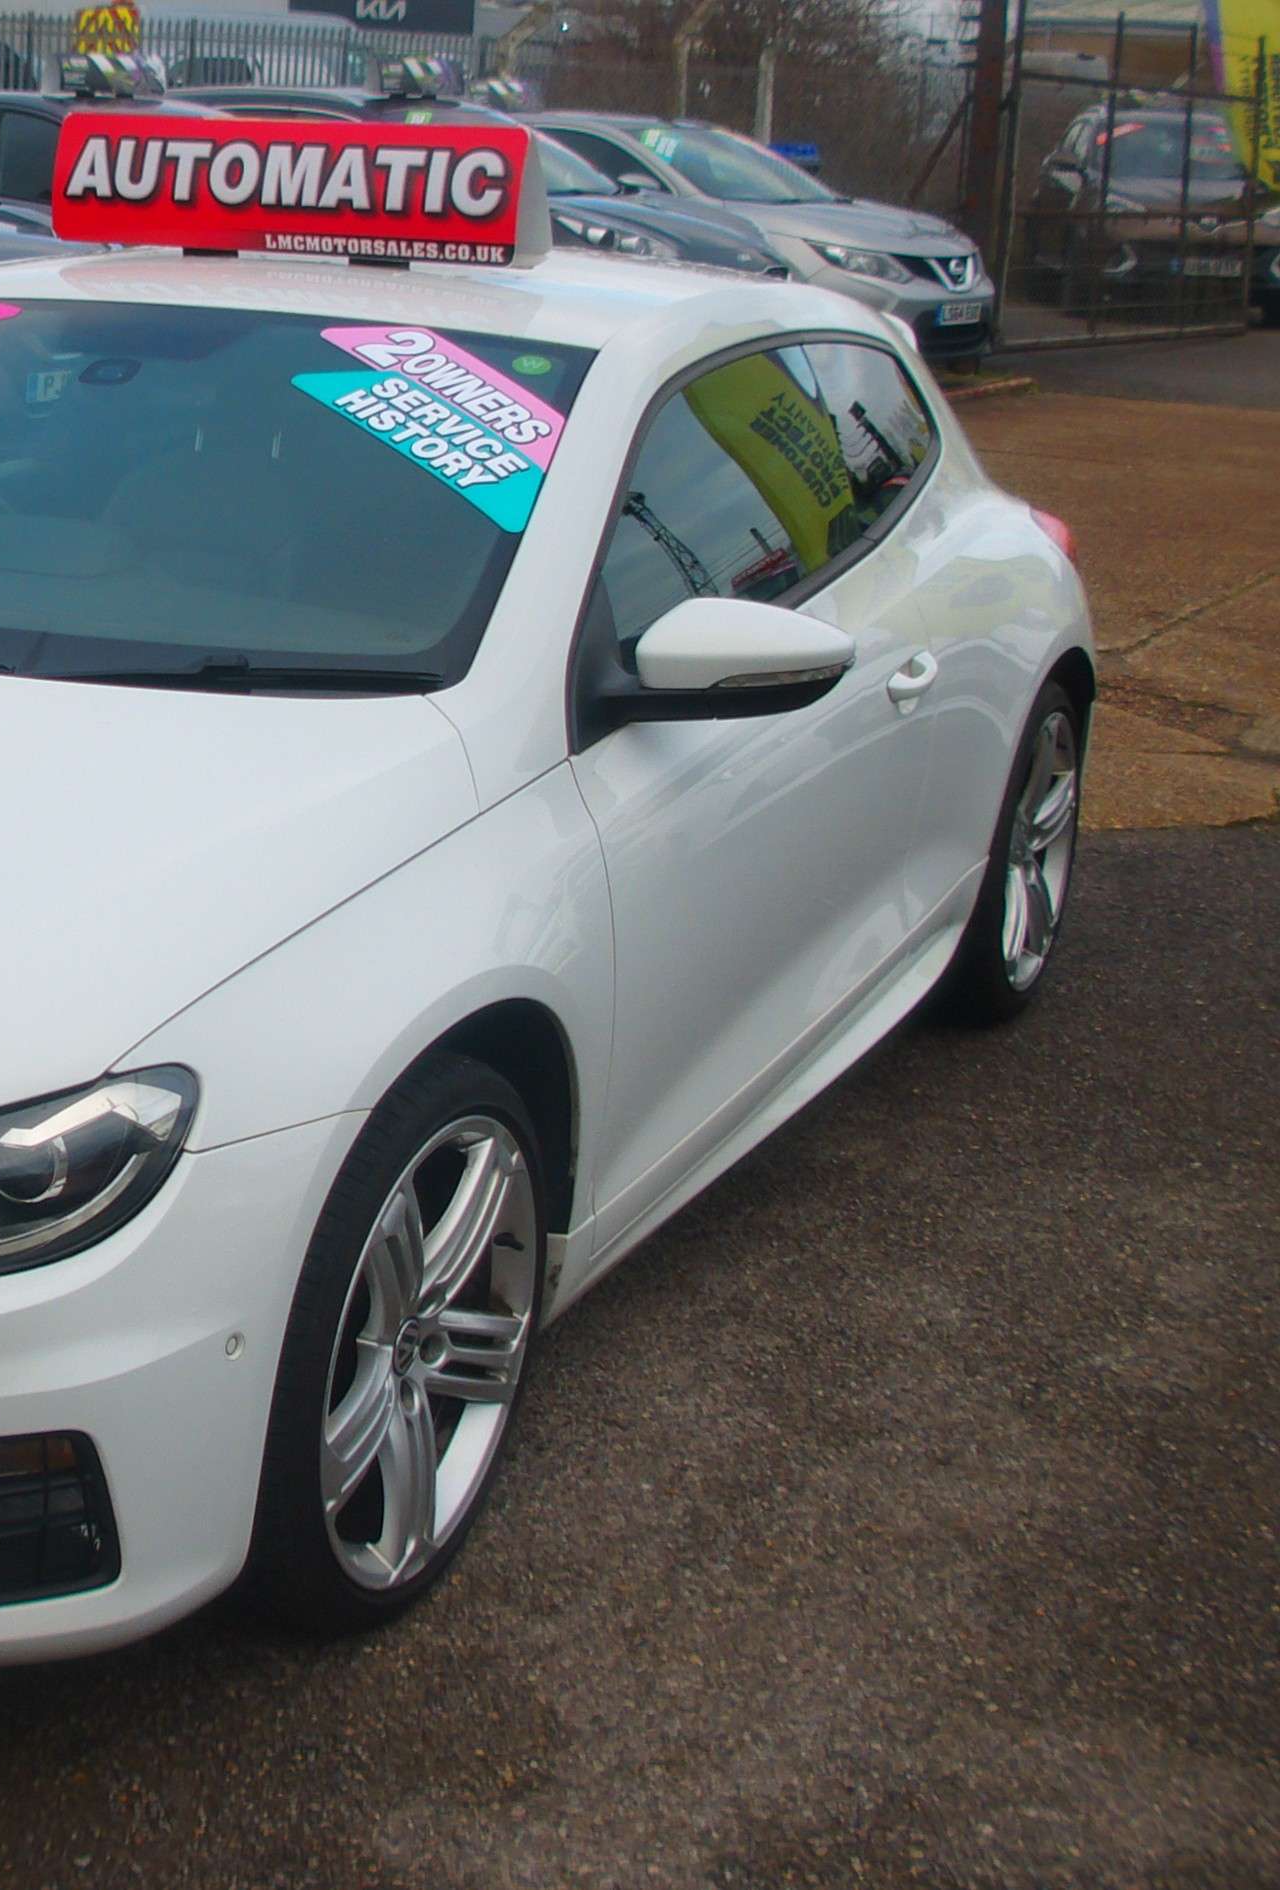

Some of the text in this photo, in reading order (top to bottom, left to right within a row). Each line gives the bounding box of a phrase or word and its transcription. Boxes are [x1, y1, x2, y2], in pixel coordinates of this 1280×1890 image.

[65, 136, 508, 217] AUTOMATIC
[265, 234, 505, 263] LMCMOTORSALES.CO.UK
[352, 330, 553, 444] 2 OWNERS
[371, 377, 530, 478] SERVICE
[334, 388, 499, 488] HISTORY
